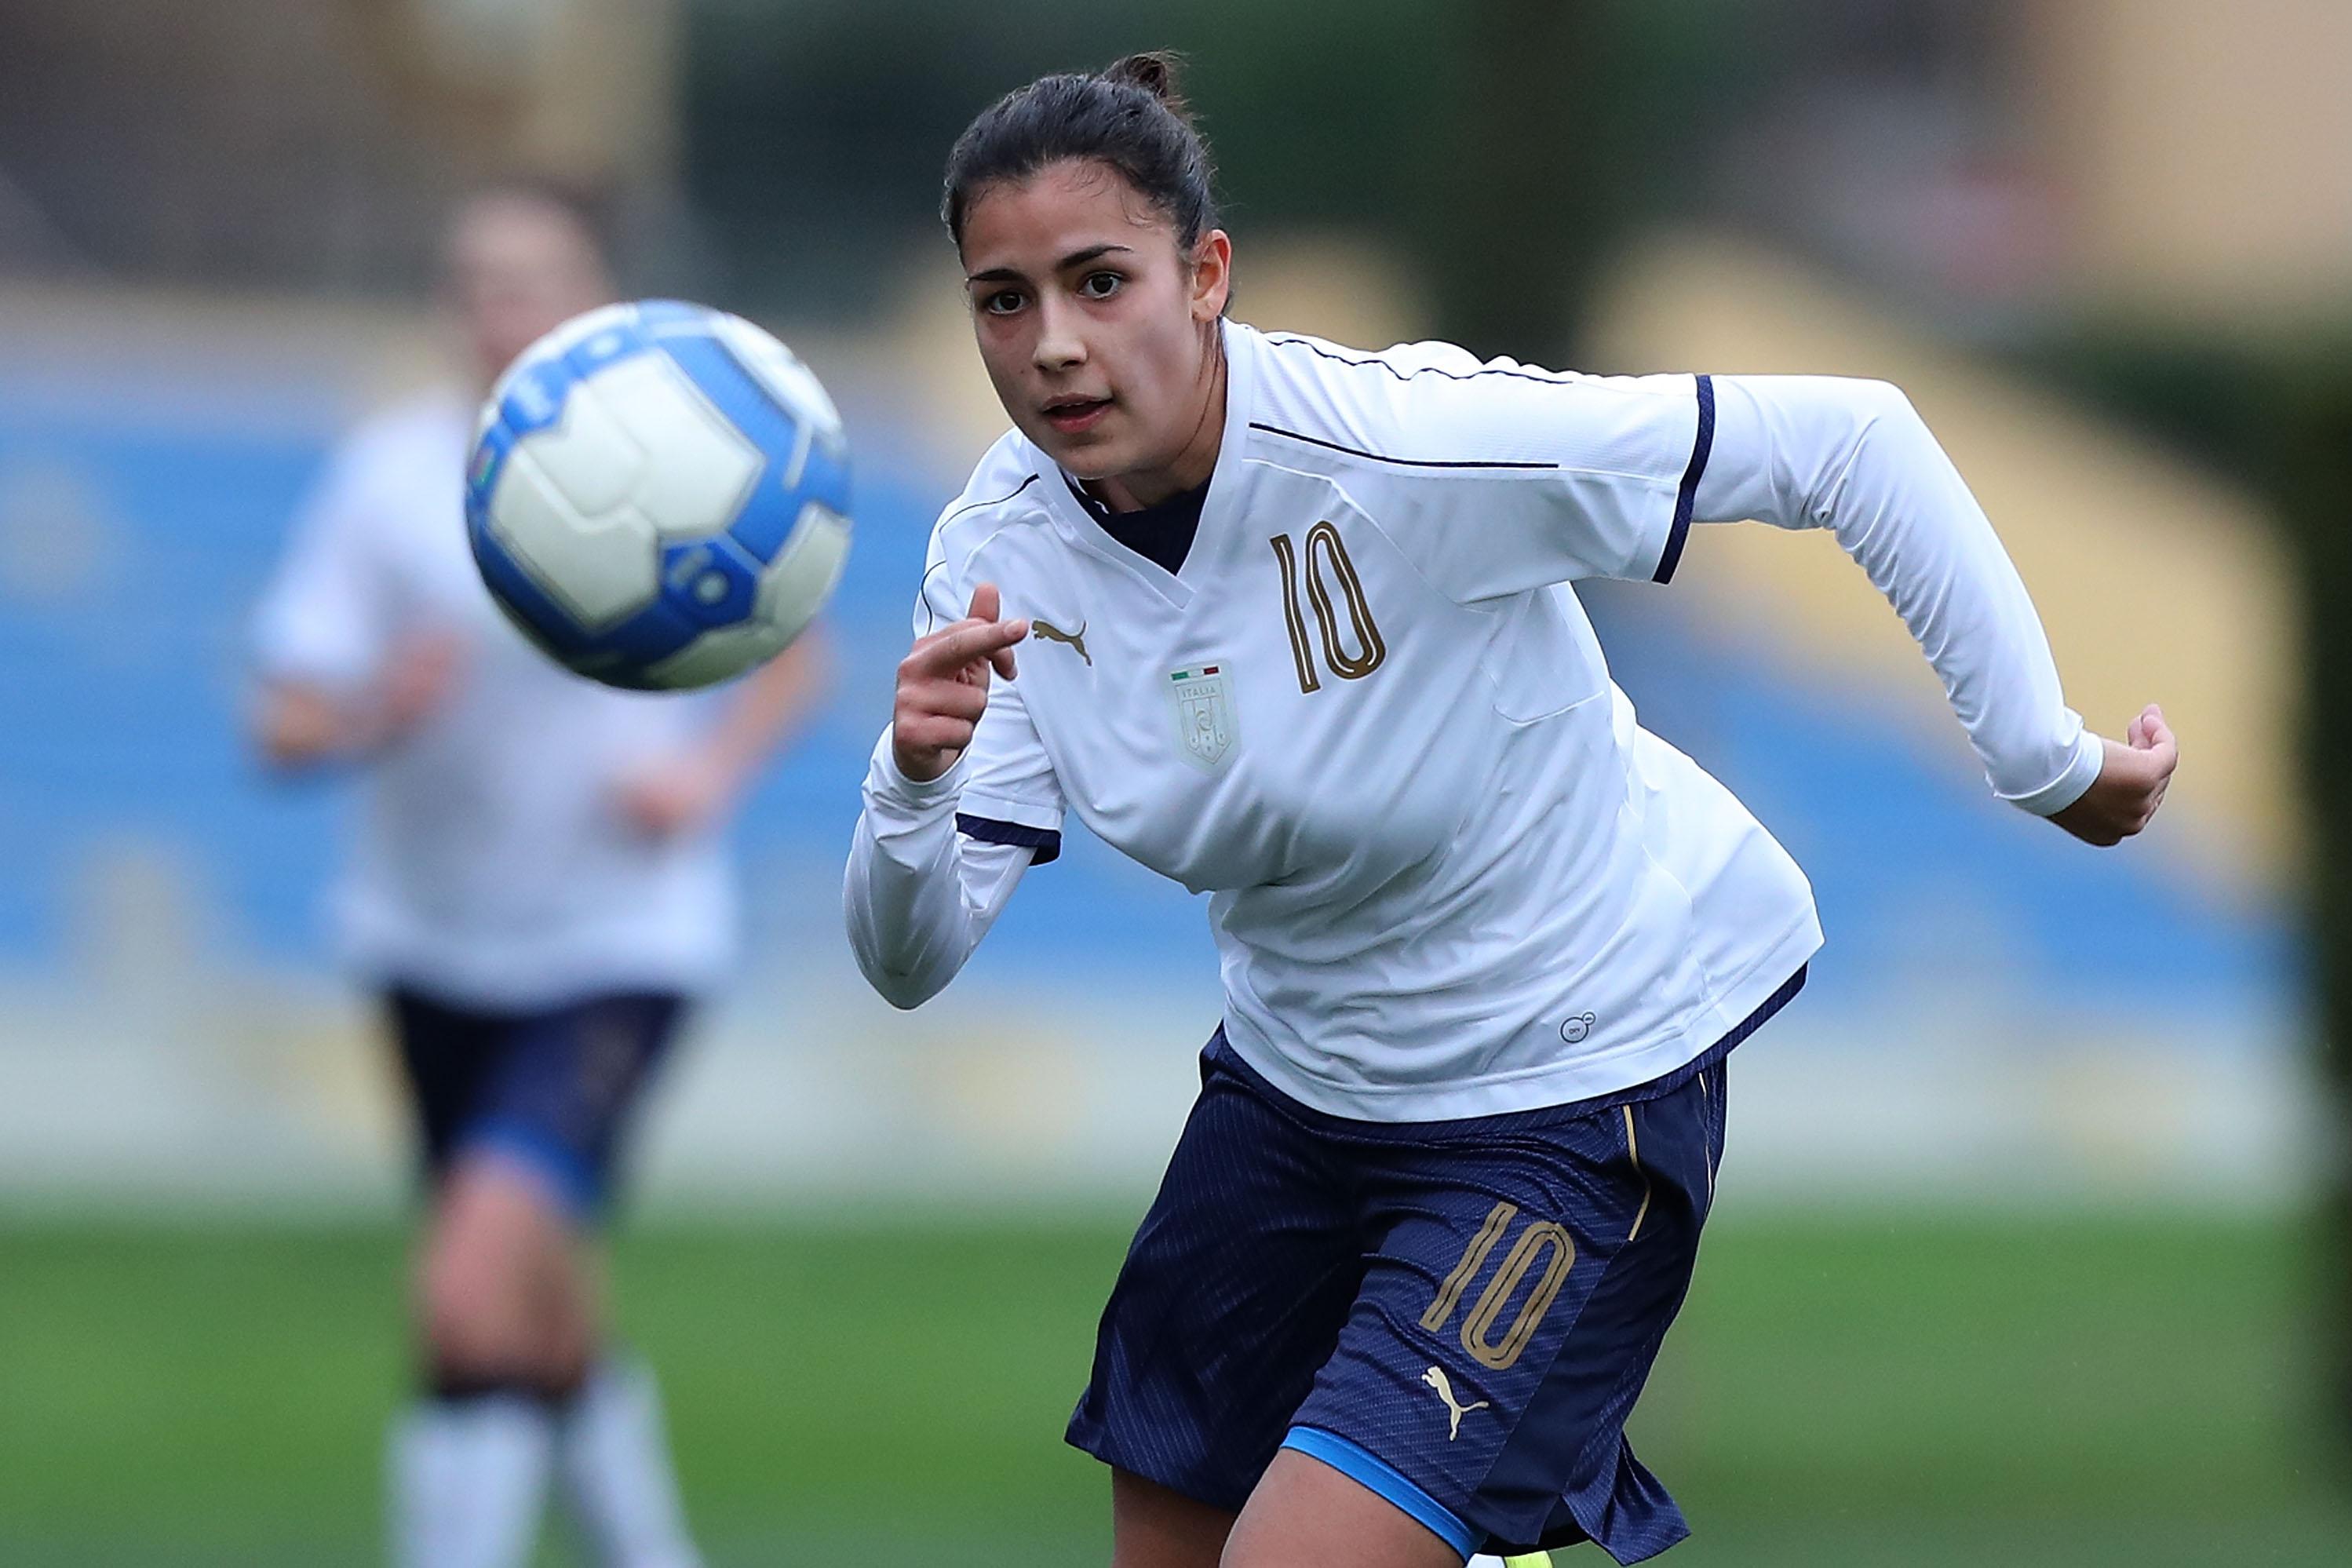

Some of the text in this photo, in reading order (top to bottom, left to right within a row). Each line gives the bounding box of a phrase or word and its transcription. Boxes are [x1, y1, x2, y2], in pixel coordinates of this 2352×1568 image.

[1270, 521, 1385, 693] 10
[1183, 687, 1216, 698] ITALIA
[1420, 1202, 1575, 1369] 10
